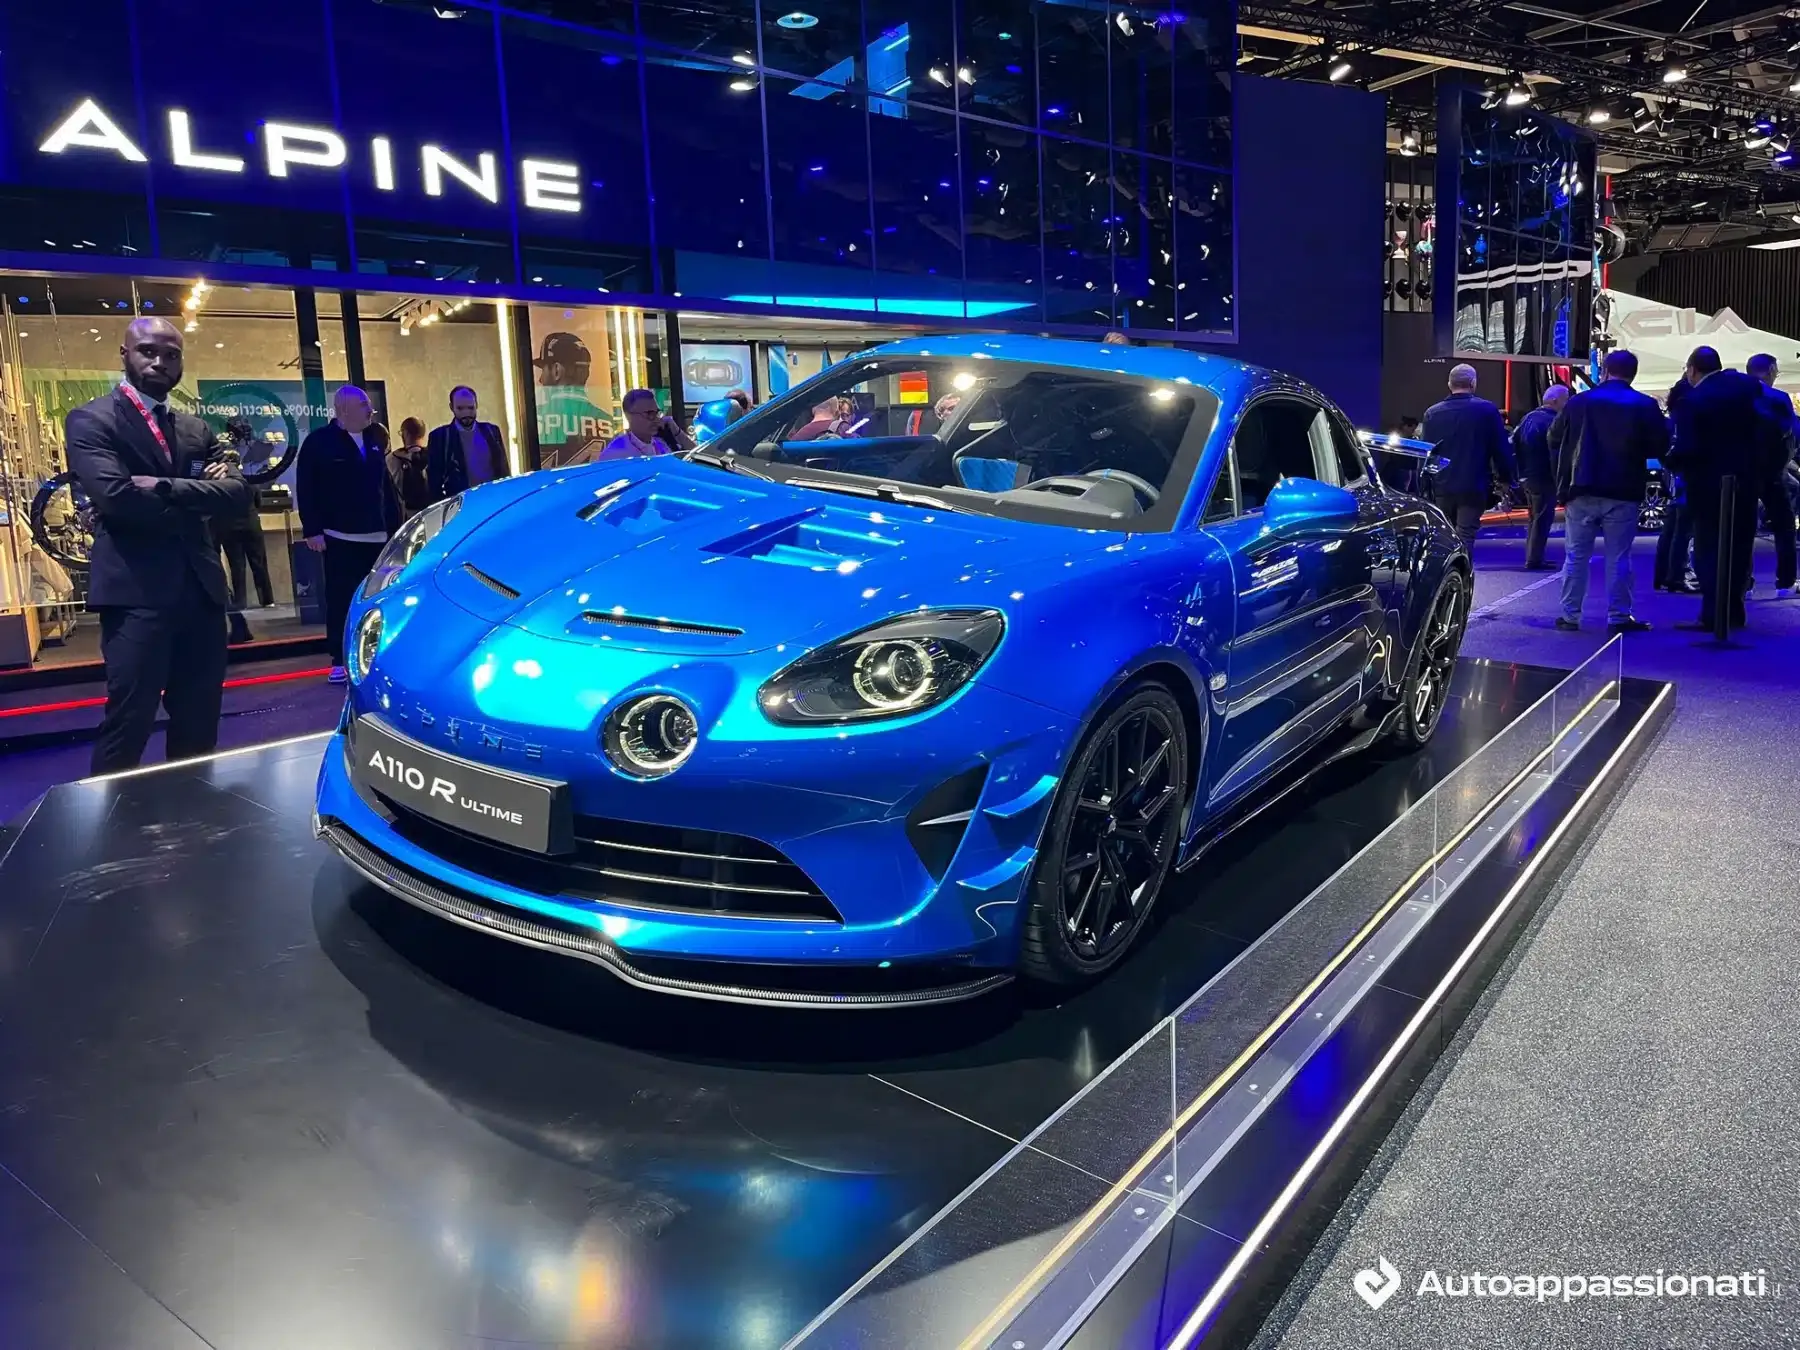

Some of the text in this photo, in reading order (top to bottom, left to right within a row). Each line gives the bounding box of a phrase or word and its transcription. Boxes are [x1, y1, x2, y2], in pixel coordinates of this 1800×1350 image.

[39, 97, 581, 213] ALPINE
[369, 750, 523, 825] A110 R ULTIME
